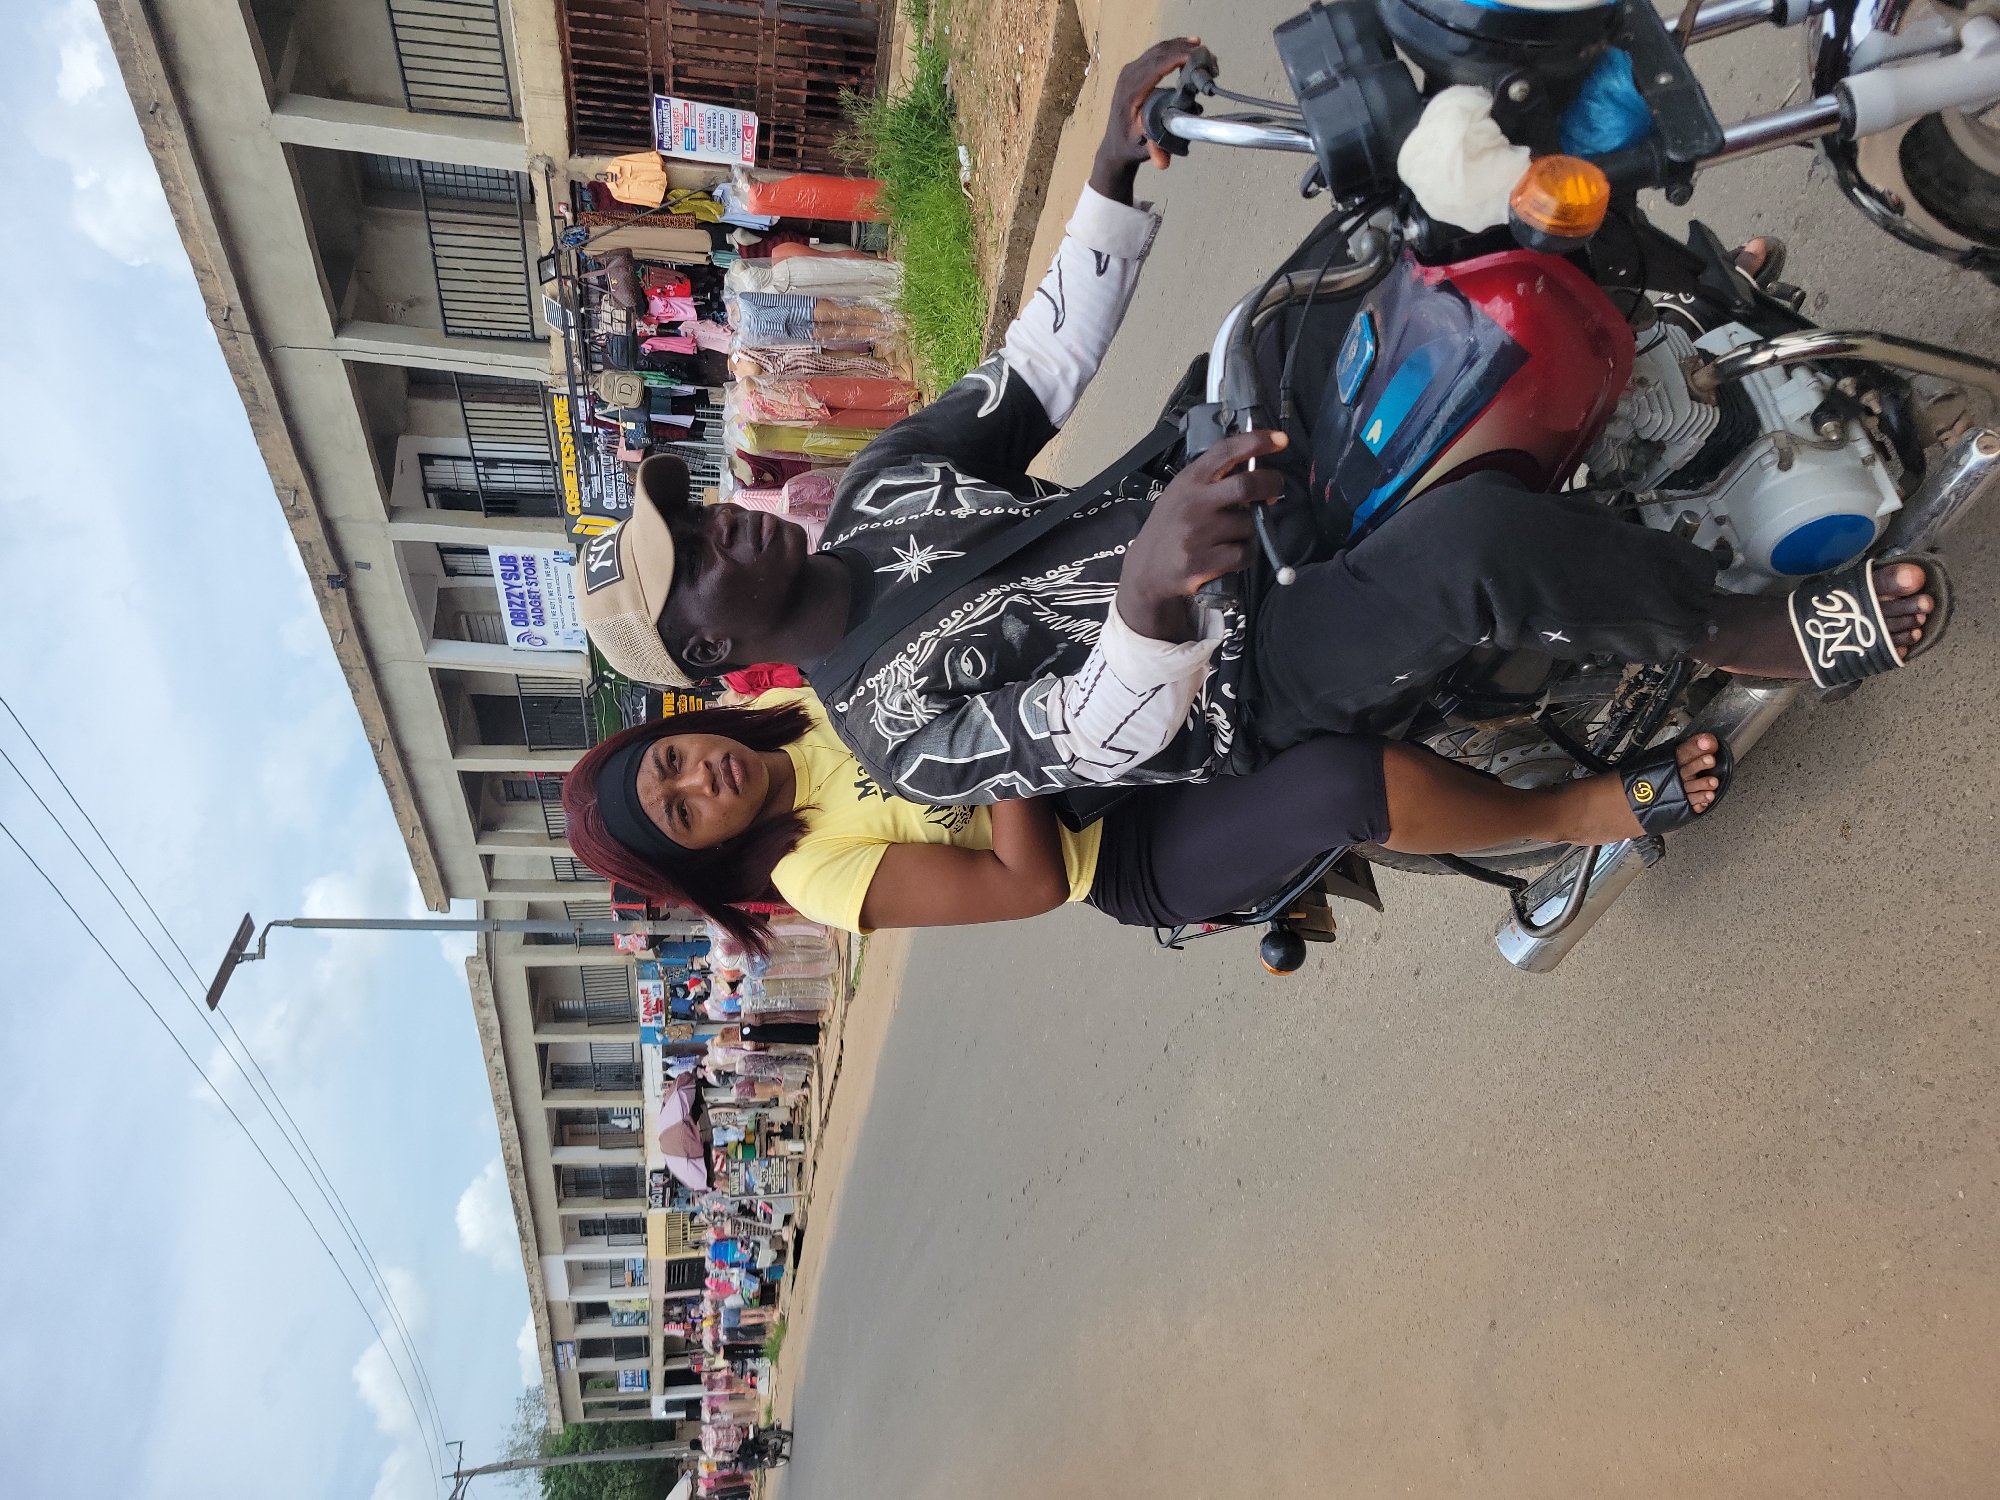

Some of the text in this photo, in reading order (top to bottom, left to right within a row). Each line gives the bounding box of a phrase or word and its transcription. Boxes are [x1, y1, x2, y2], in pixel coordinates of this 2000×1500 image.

[663, 100, 672, 149] SUPERMARKET
[699, 136, 705, 146] WE
[521, 556, 545, 627] GADGET STORE
[853, 757, 878, 802] Ma
